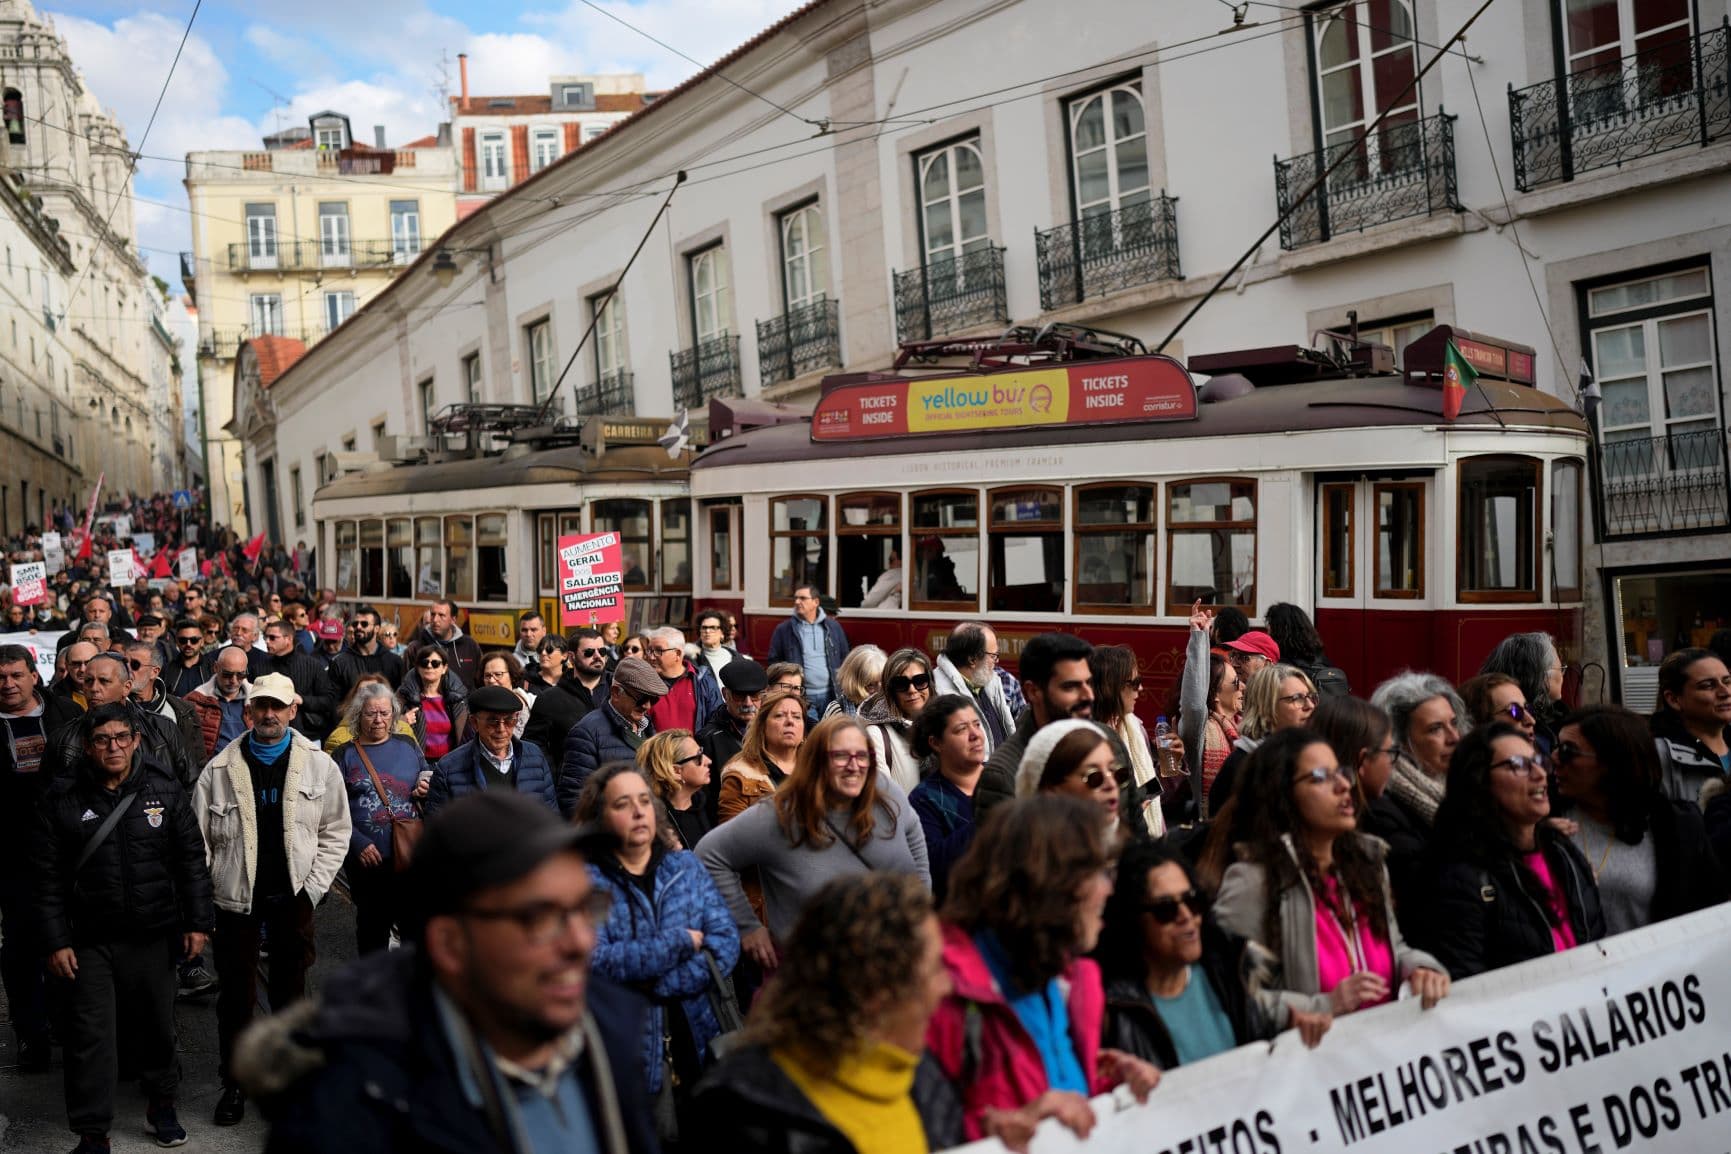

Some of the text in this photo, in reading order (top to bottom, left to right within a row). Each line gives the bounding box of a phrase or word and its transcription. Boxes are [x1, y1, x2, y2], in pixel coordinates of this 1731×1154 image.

[1081, 375, 1128, 391] TICKETS
[859, 395, 897, 409] TICKETS
[922, 387, 988, 410] yellow
[1086, 393, 1124, 408] INSIDE
[862, 411, 894, 424] INSIDE
[604, 424, 653, 439] CARREIRA
[563, 535, 614, 558] AUMENTO
[569, 554, 601, 567] GERAL
[564, 585, 620, 603] EMERGÊNCIA
[568, 597, 616, 611] NACIONAL!
[1330, 1031, 1526, 1147] MELHORES
[1532, 974, 1706, 1073] SALÁRIOS
[1602, 1076, 1682, 1149] DOS
